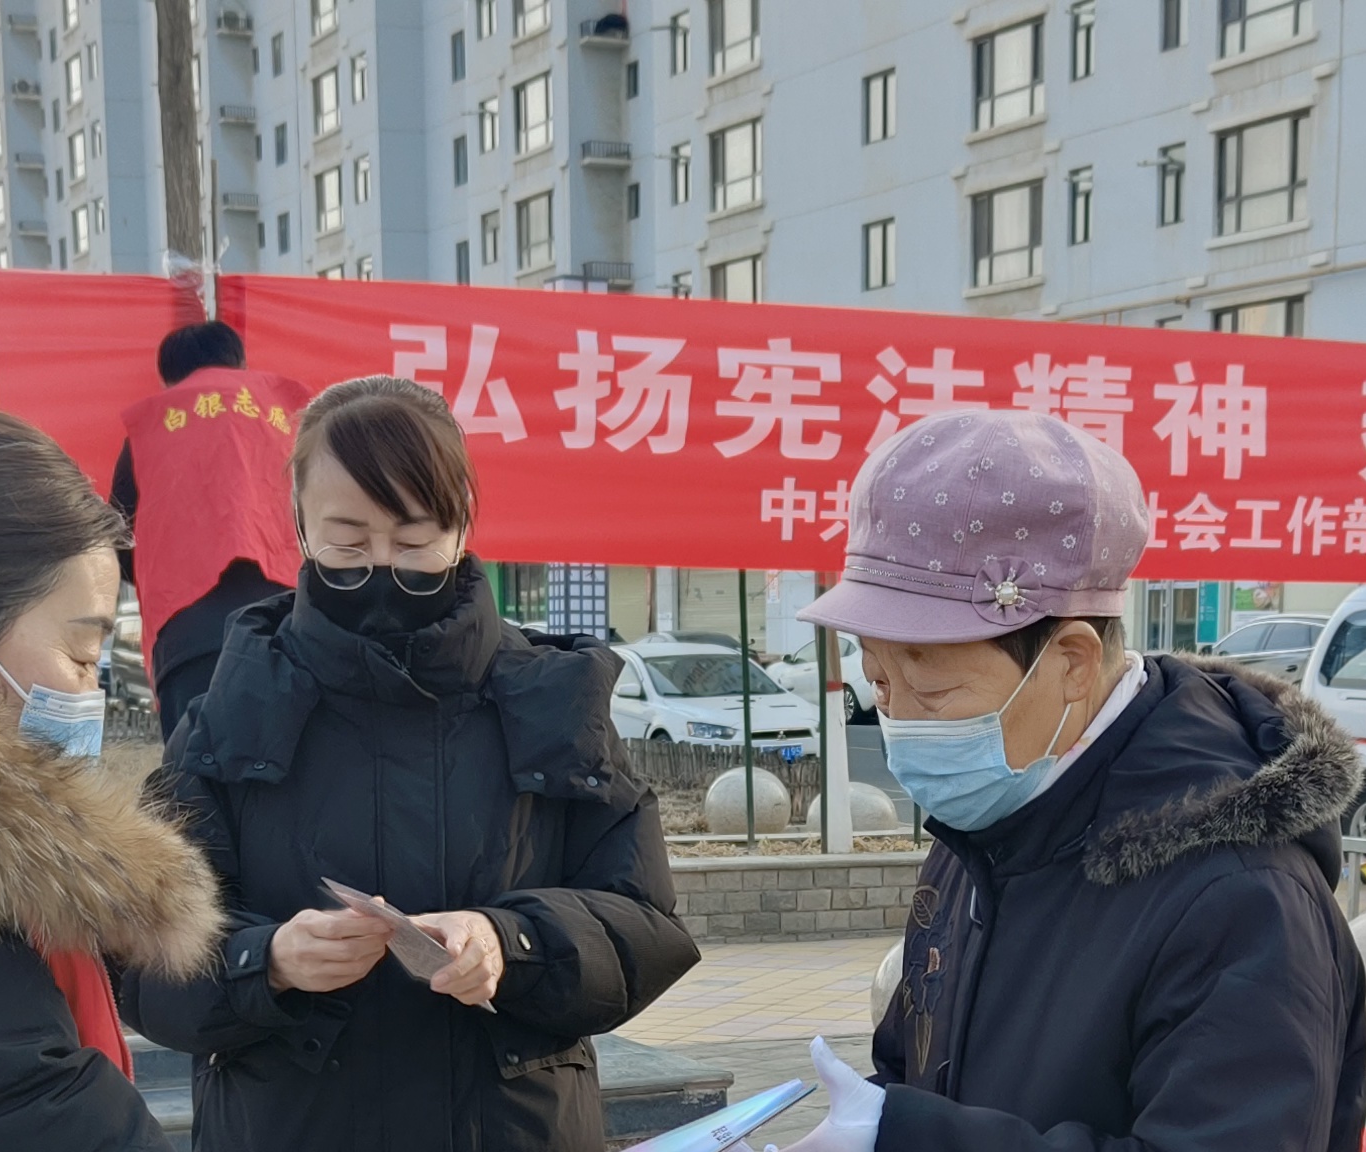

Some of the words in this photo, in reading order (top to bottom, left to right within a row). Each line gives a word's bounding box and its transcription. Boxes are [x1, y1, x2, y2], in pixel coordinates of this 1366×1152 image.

[389, 322, 1268, 480] 弘扬宪法精神
